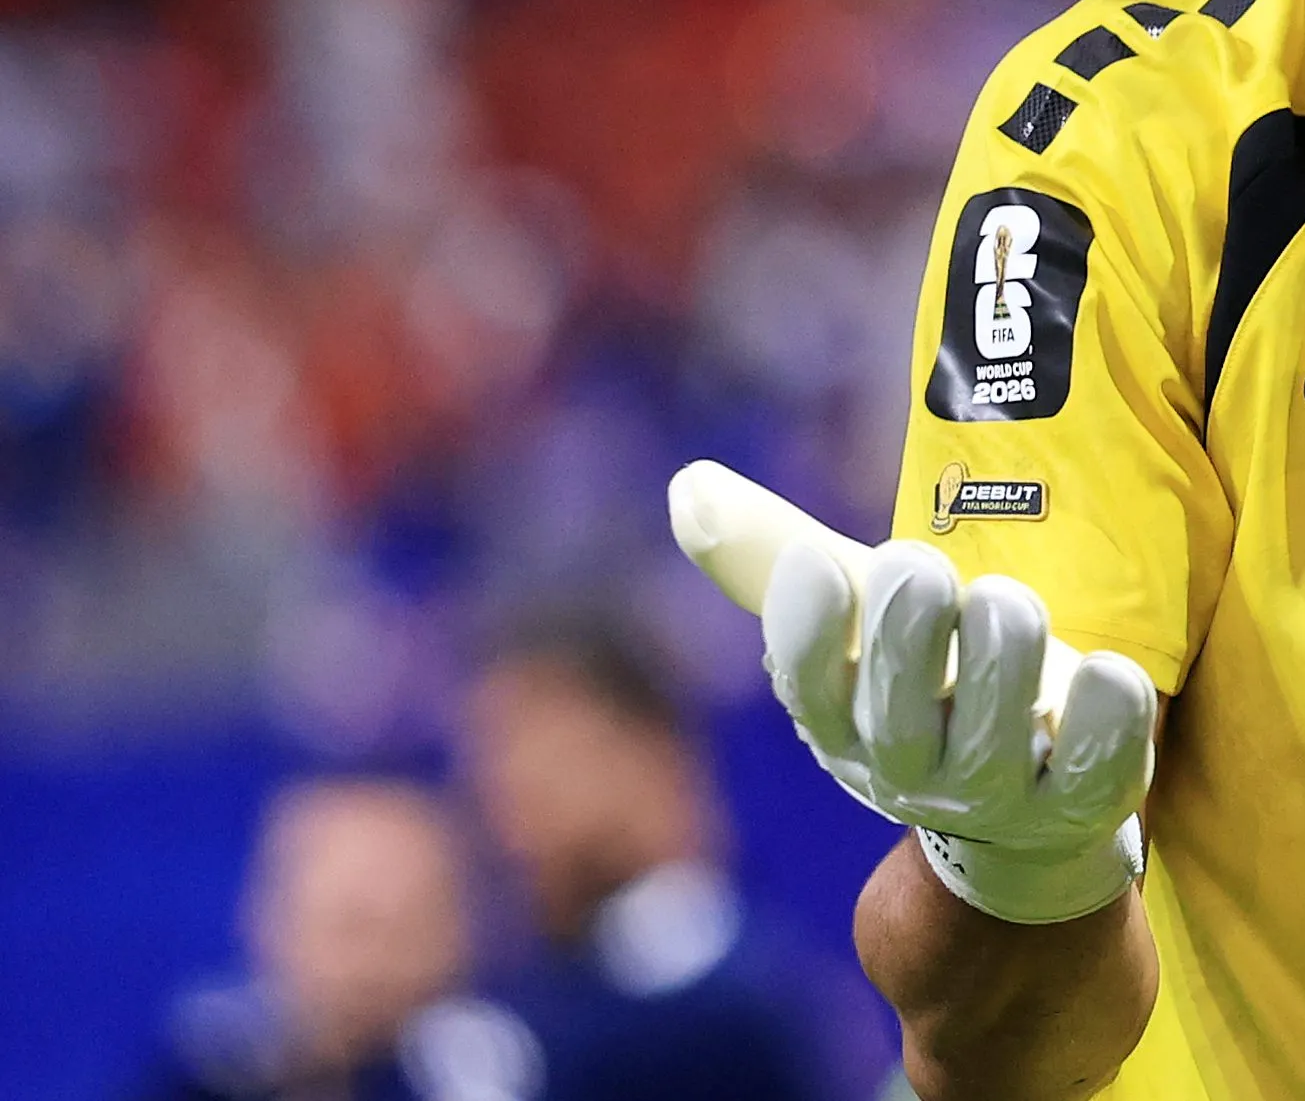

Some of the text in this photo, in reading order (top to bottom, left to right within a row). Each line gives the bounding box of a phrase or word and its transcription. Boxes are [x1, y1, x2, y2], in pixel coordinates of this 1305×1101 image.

[991, 327, 1015, 344] FIFA
[975, 360, 1033, 380] WORLD CUP
[971, 377, 1036, 405] 2026
[960, 484, 1038, 500] DEBUT
[980, 501, 1012, 511] WORLD
[1011, 501, 1030, 511] CUP
